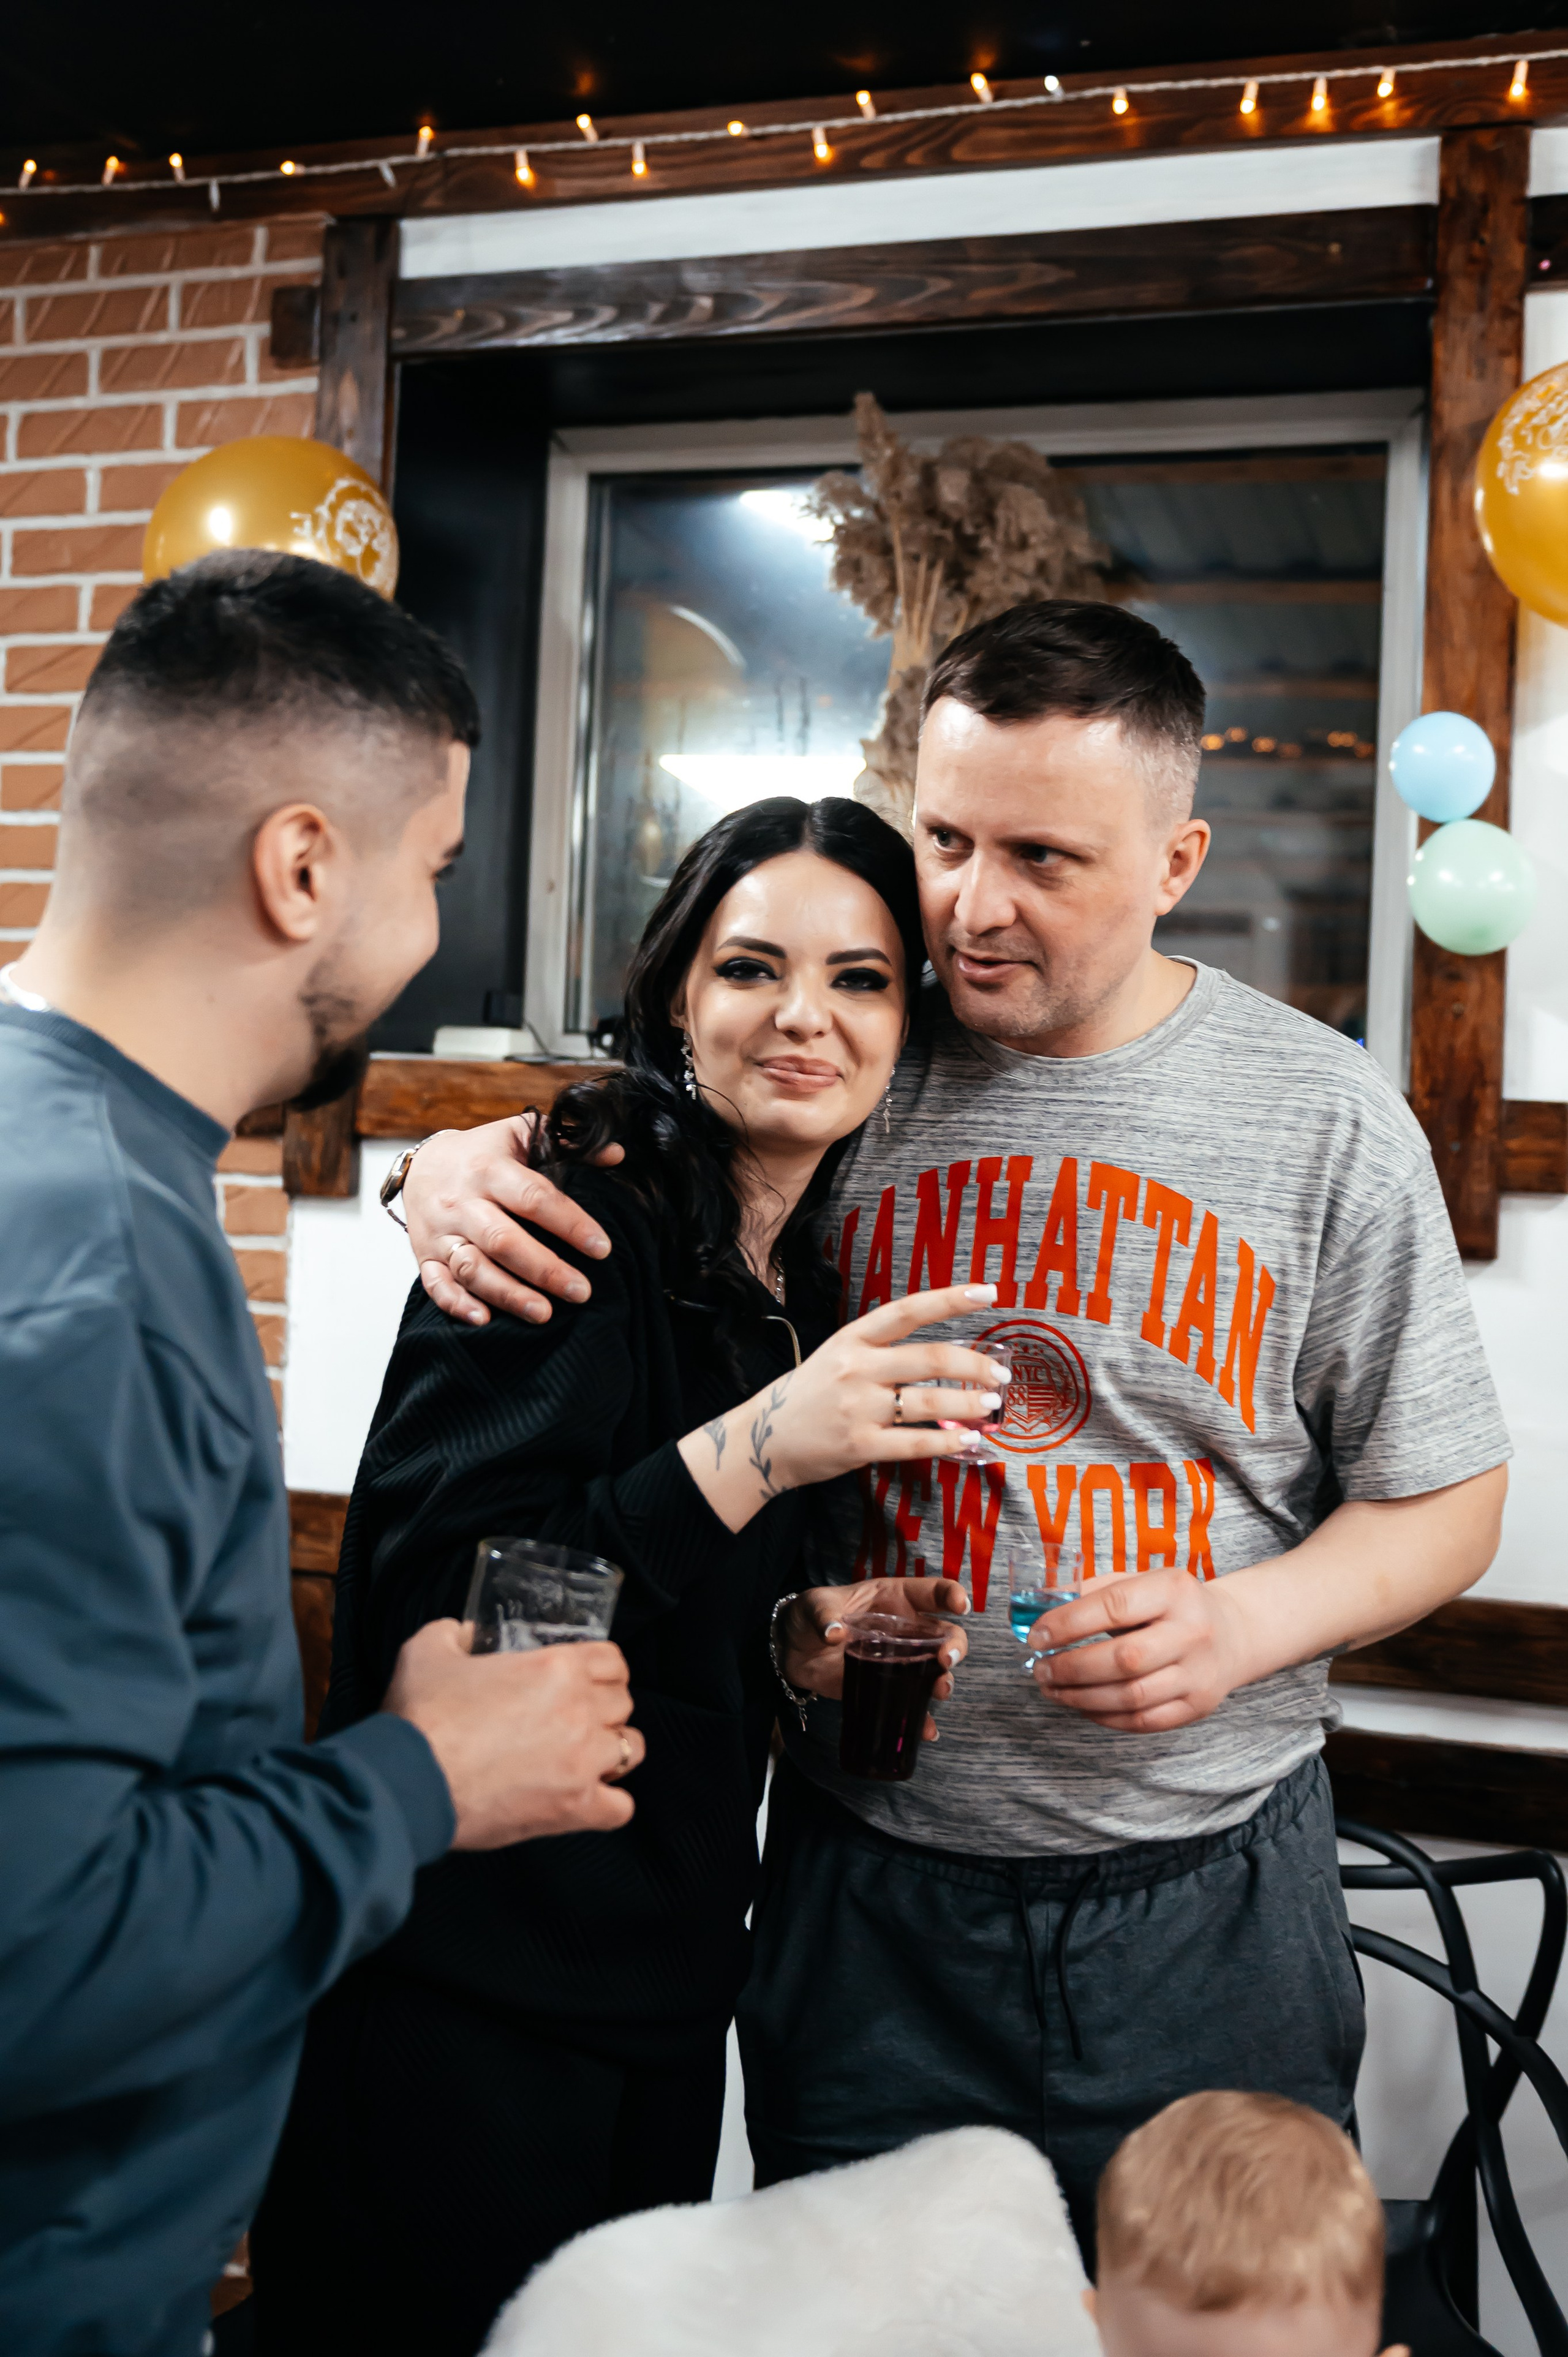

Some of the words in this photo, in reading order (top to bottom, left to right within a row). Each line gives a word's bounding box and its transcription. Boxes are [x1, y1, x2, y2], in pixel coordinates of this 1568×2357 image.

[1012, 1364, 1044, 1382] NYC
[852, 1458, 1006, 1612] NEW
[1027, 1457, 1216, 1588] YORK
